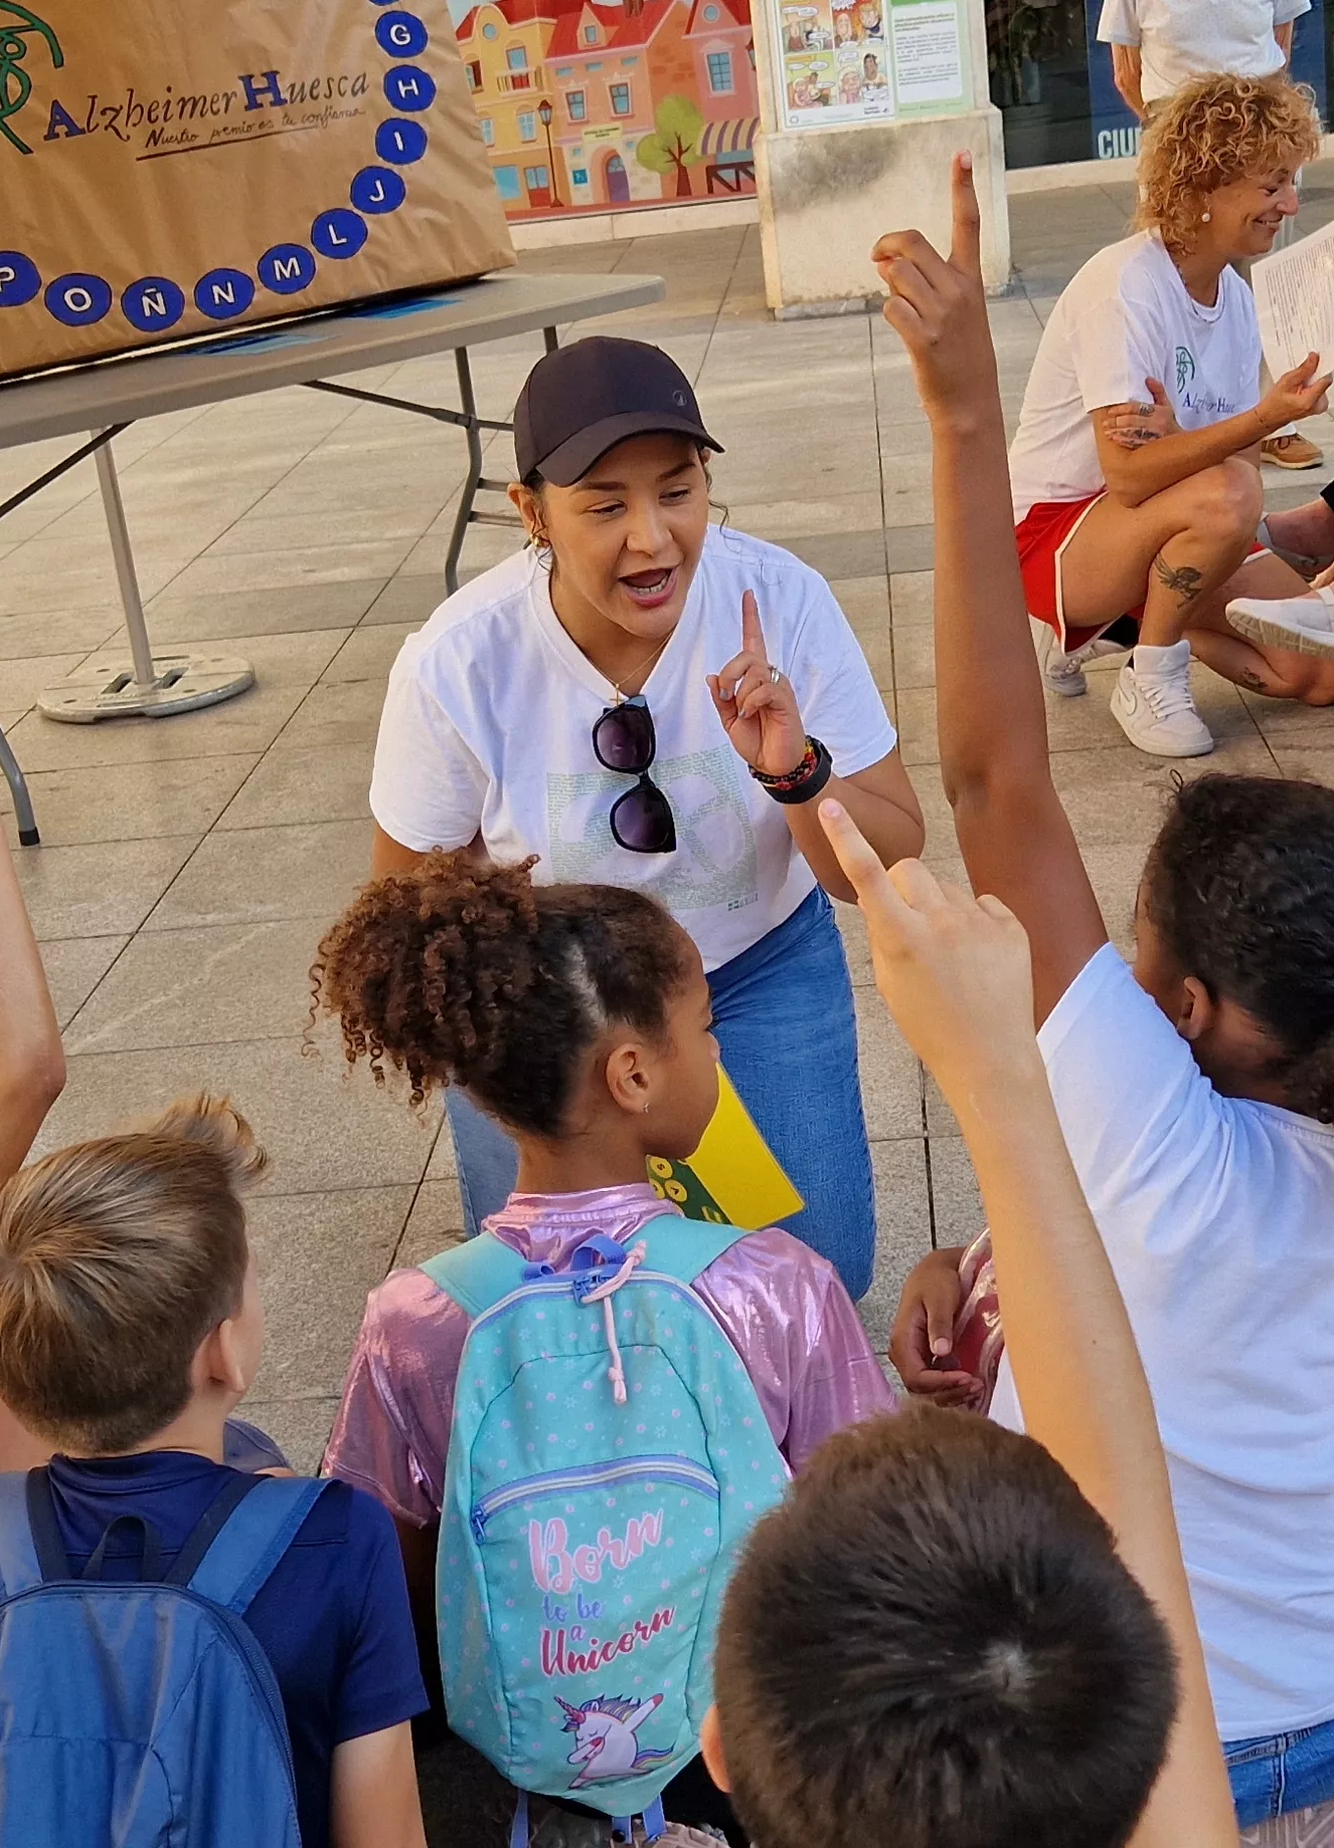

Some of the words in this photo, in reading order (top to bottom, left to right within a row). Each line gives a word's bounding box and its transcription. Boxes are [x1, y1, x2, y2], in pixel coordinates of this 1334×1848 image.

[389, 23, 412, 46] G
[397, 78, 420, 99] H
[43, 86, 237, 142] Alzheimer
[238, 70, 370, 112] Huesca
[393, 131, 404, 152] I
[368, 178, 385, 203] J
[328, 223, 348, 245] L
[273, 256, 302, 282] M
[63, 287, 93, 313] O
[141, 287, 167, 318] Ñ
[211, 281, 236, 306] N
[528, 1507, 664, 1594] Born
[541, 1594, 570, 1622] to
[576, 1592, 604, 1620] be
[539, 1605, 676, 1678] Unicorn
[570, 1624, 587, 1642] a
